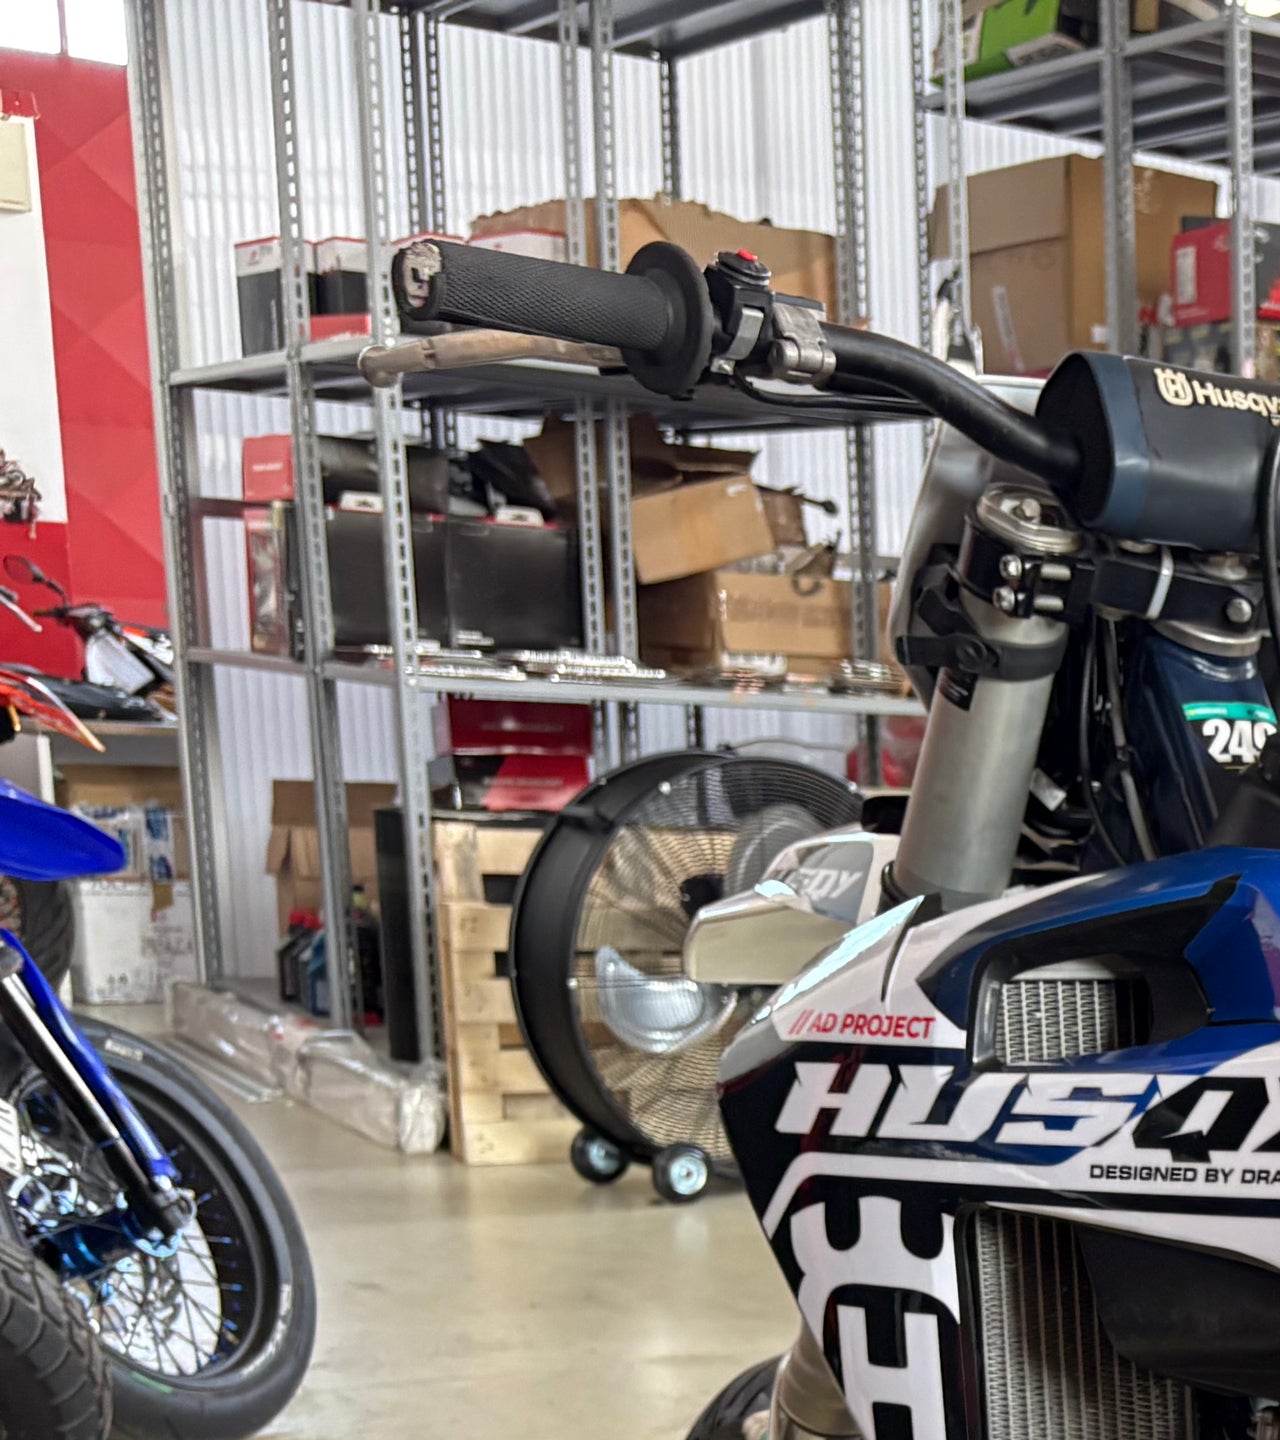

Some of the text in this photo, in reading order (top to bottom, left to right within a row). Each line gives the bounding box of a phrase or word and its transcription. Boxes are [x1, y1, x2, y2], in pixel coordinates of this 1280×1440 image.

[839, 1013, 937, 1039] PROJECT
[1089, 1164, 1198, 1183] DESIGNED
[1204, 1167, 1235, 1184] BY
